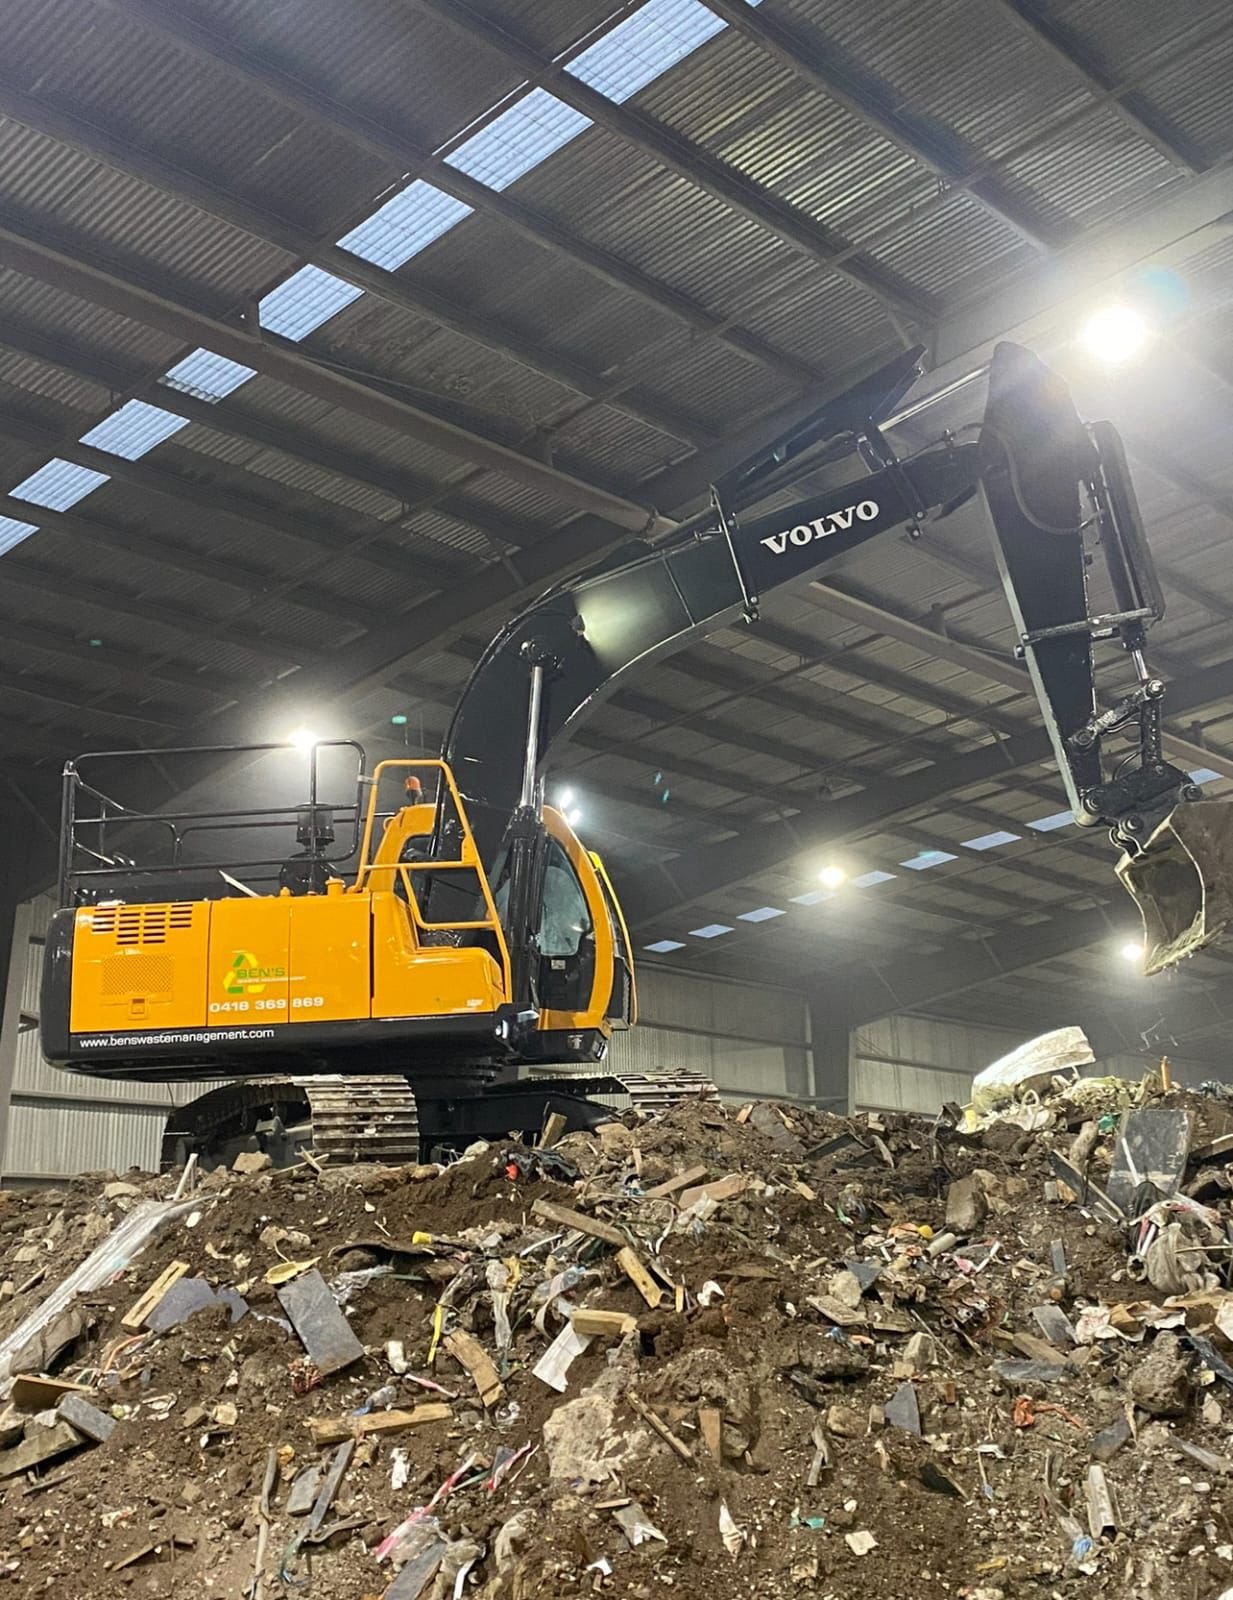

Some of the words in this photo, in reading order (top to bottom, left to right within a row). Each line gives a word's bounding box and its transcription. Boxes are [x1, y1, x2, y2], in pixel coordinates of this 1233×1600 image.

[760, 500, 880, 555] VOLVO
[236, 967, 286, 978] BEN'S
[209, 1001, 249, 1013] 0418
[255, 999, 287, 1010] 369
[292, 996, 325, 1008] 869
[79, 1029, 275, 1047] www.benswastemanagement.com
